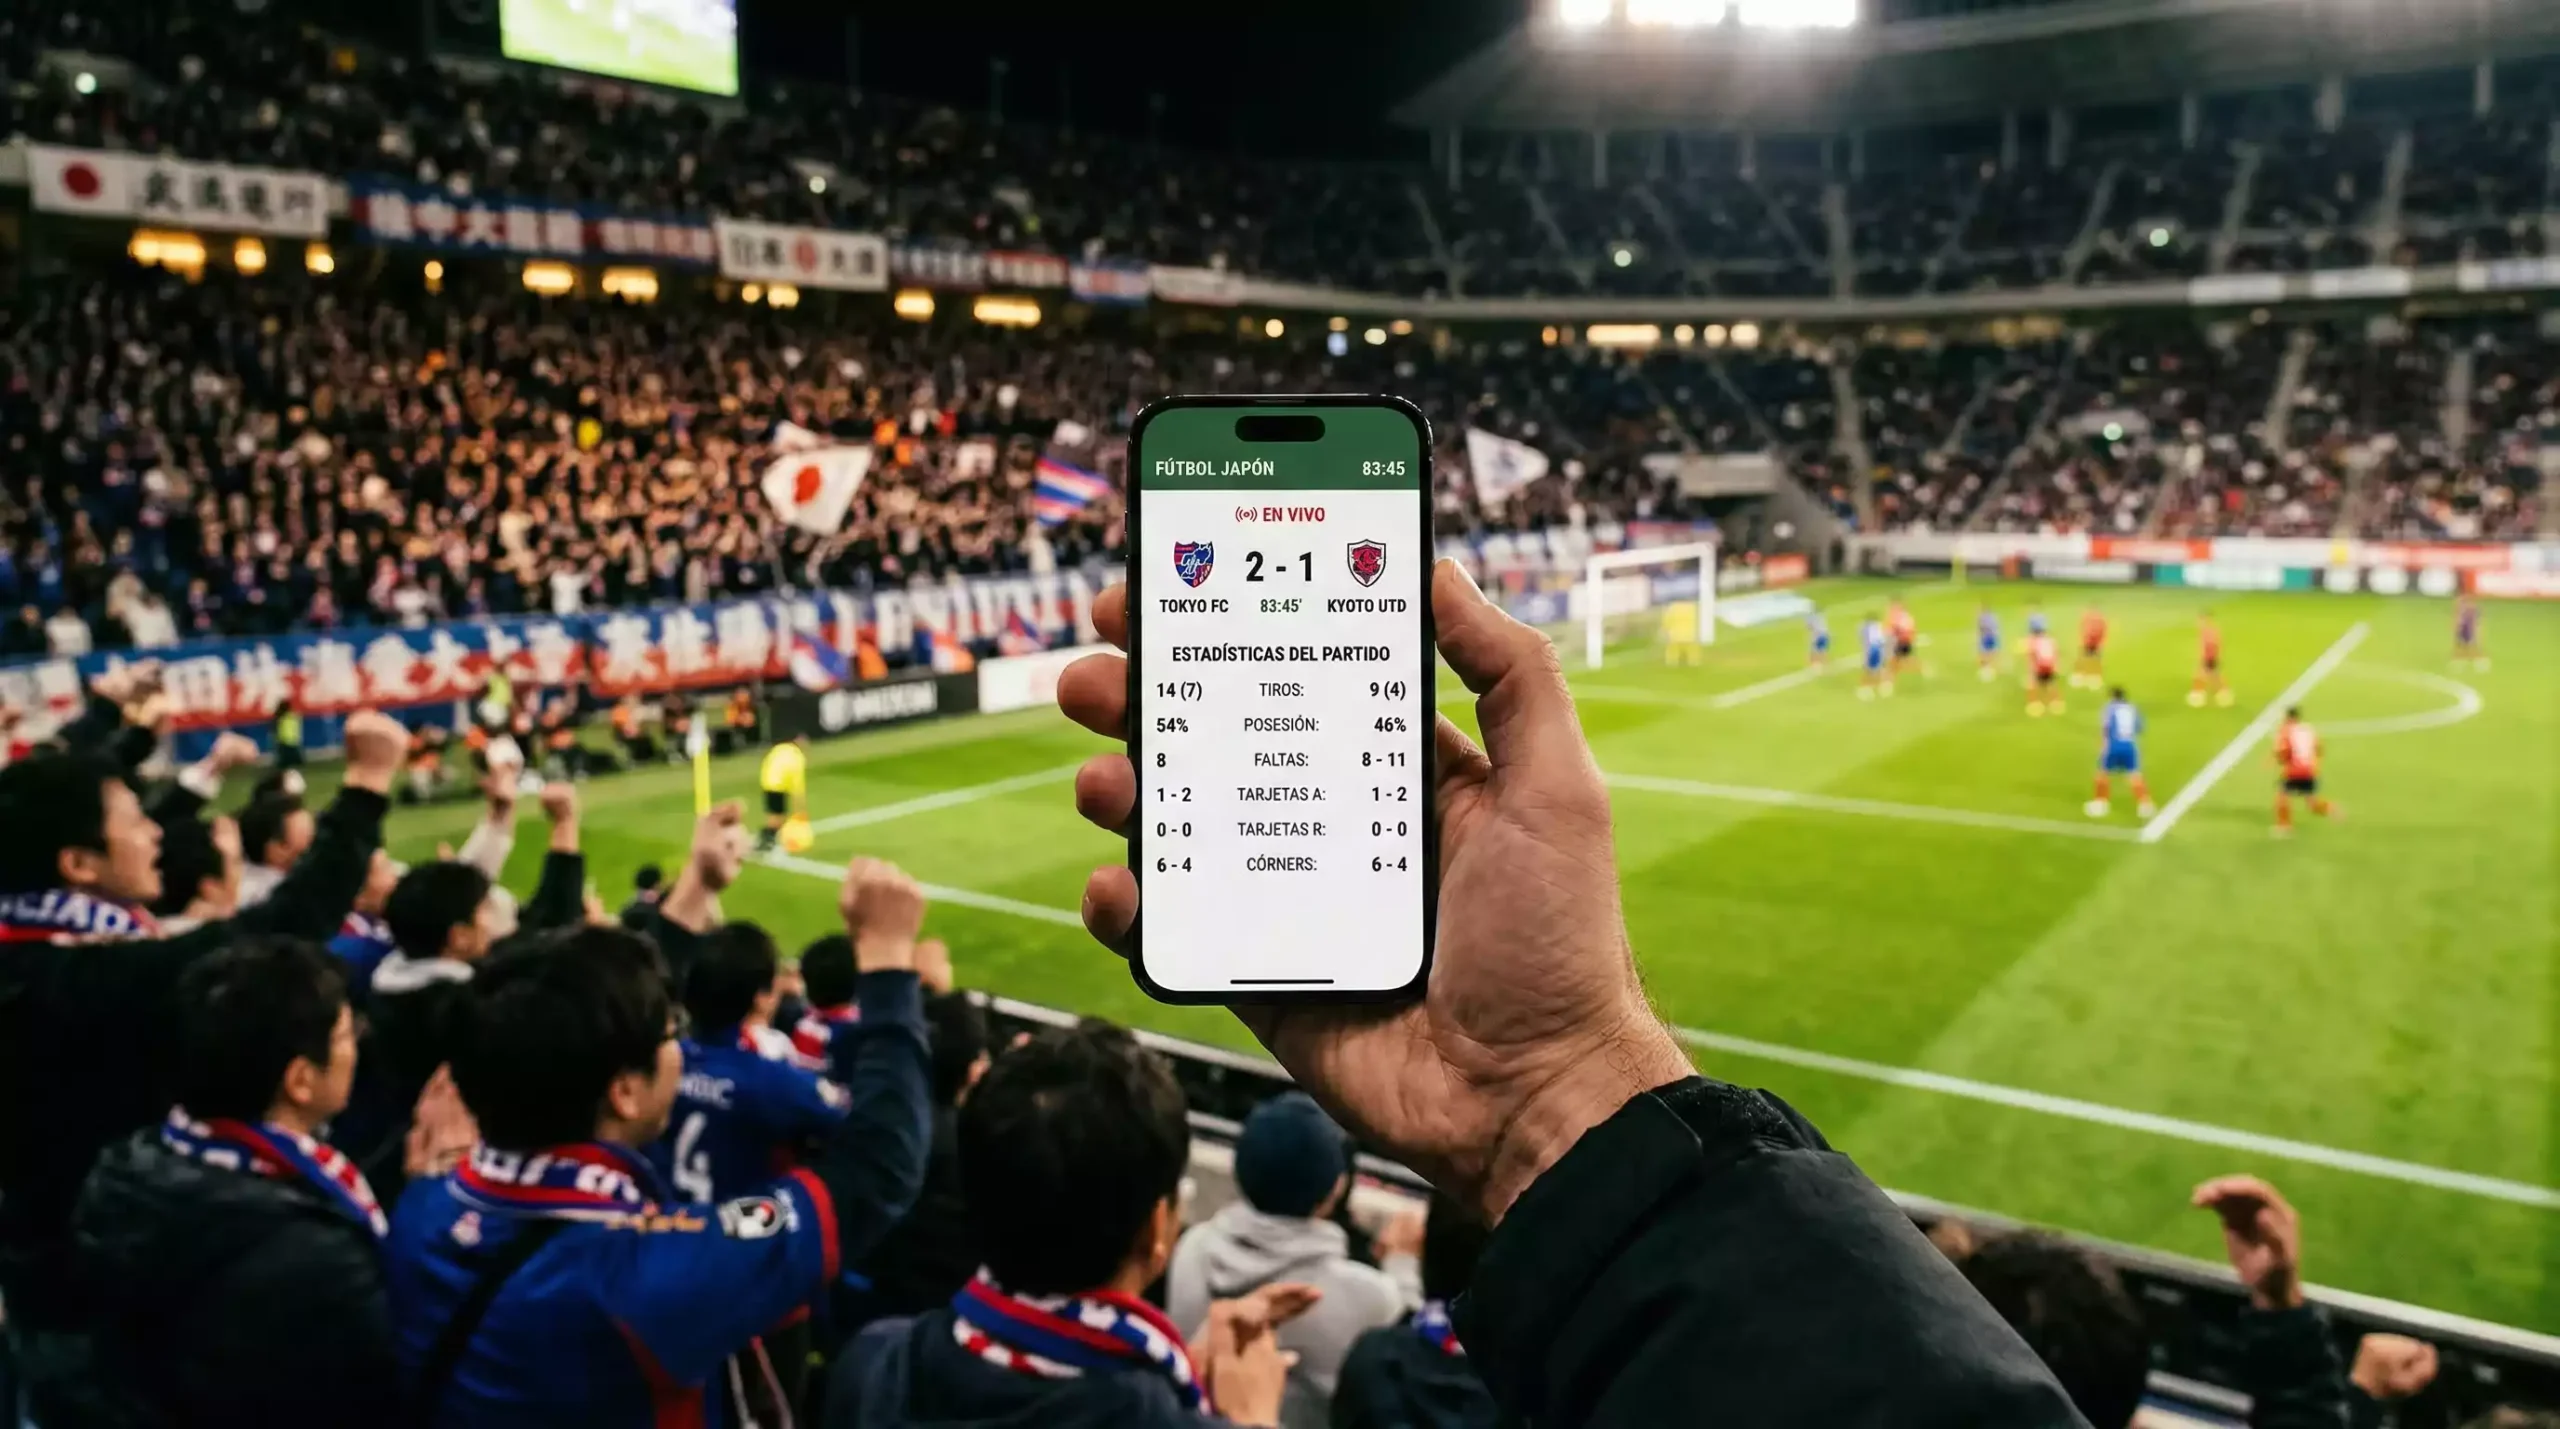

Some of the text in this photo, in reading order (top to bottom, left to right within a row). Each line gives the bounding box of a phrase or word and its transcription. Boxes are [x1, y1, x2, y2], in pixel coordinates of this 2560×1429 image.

[1155, 457, 1275, 476] FÚTBOL JAPÓN
[1362, 460, 1406, 476] 83:45
[1262, 506, 1326, 523] EN VIVO
[1245, 550, 1265, 583] 2
[1298, 551, 1313, 582] 1
[1158, 598, 1230, 614] TOKYO FC
[1260, 598, 1303, 613] 83:45'
[1327, 598, 1407, 613] KYOTO UTD
[1172, 642, 1391, 662] ESTADÍSTICAS DEL PARTIDO
[1156, 680, 1407, 702] 14 (7) TIROS: 9 (4)
[1156, 714, 1407, 734] 54% POSESIÓN: 46%
[1156, 752, 1167, 769] 8
[1254, 752, 1309, 767] FALTAS:
[1361, 751, 1372, 768] 8
[1387, 751, 1406, 768] 11
[1156, 787, 1165, 803] 1
[1181, 786, 1192, 803] 2
[1236, 786, 1309, 802] TARJETAS
[1311, 787, 1326, 801] A:
[1371, 786, 1380, 802] 1
[1396, 785, 1408, 802] 2
[1156, 821, 1167, 838] 0
[1181, 821, 1192, 838] 0
[1236, 821, 1309, 837] TARJETAS
[1312, 821, 1326, 837] R:
[1371, 820, 1382, 837] 0
[1397, 820, 1408, 837] 0
[1156, 857, 1168, 873] 6
[1181, 856, 1193, 873] 4
[1246, 854, 1318, 872] CÓRNERS:
[1371, 856, 1383, 873] 6
[1396, 856, 1408, 872] 4
